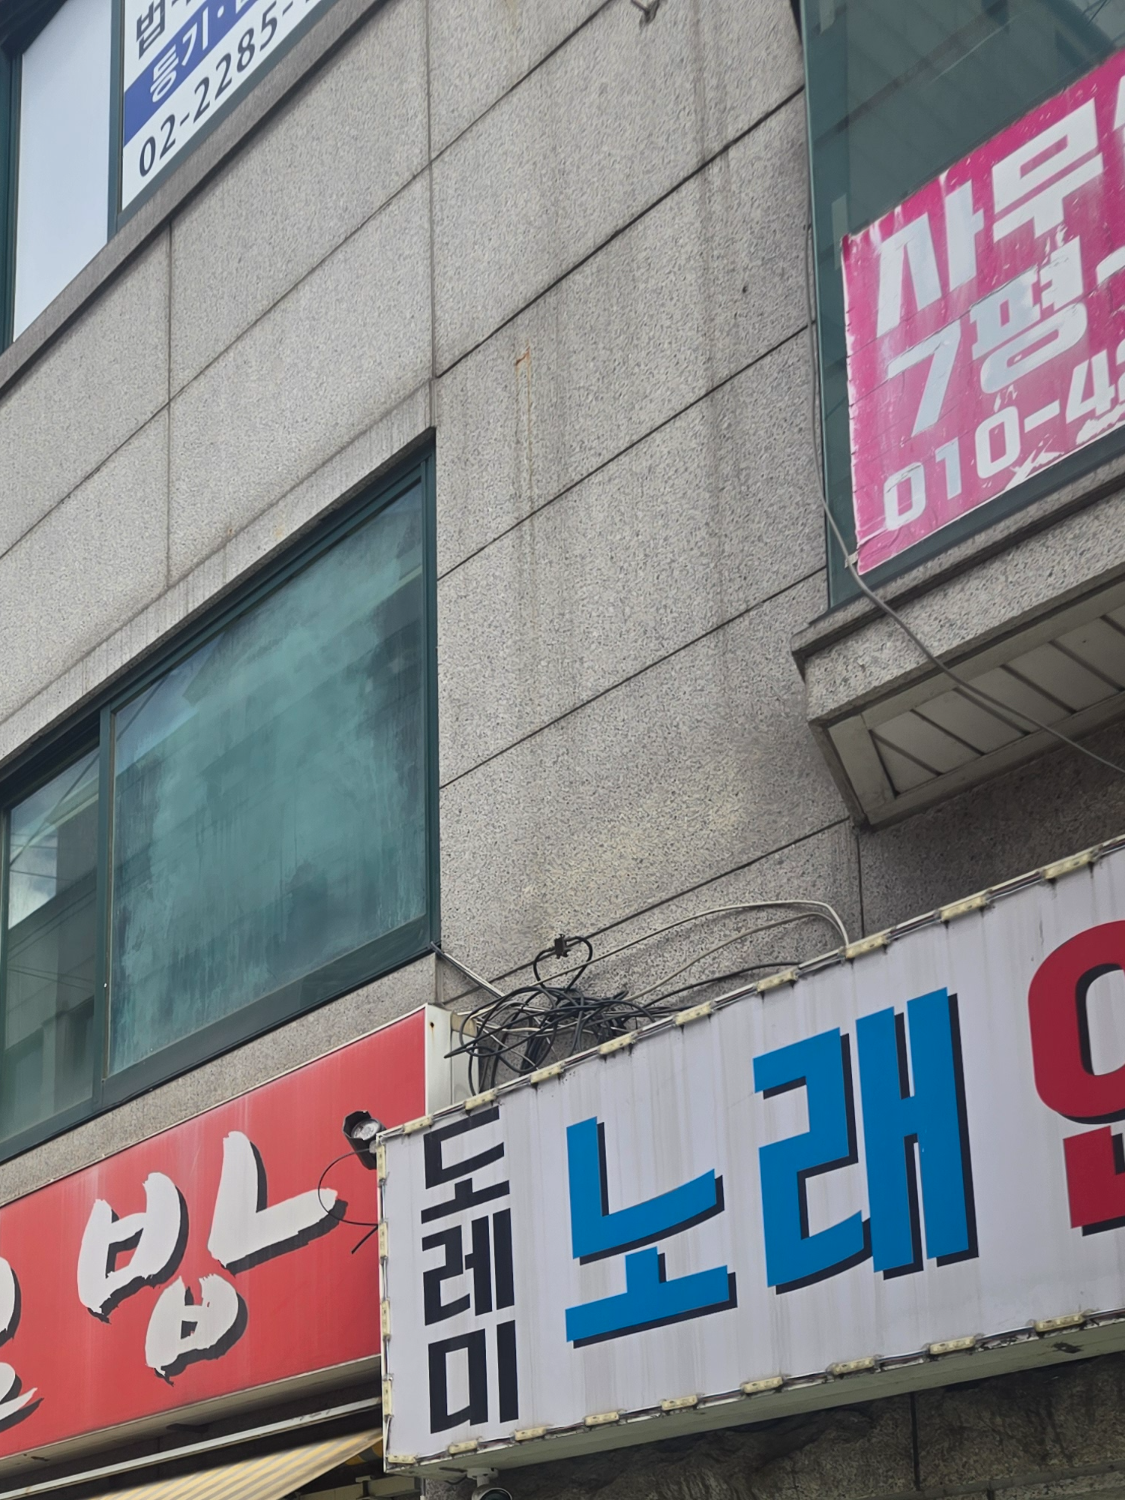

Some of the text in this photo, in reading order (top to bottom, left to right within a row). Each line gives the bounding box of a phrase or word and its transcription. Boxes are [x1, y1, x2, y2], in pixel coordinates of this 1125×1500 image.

[138, 0, 309, 177] 02-2285-
[877, 76, 1125, 339] 사무
[420, 1106, 520, 1434] 도레미
